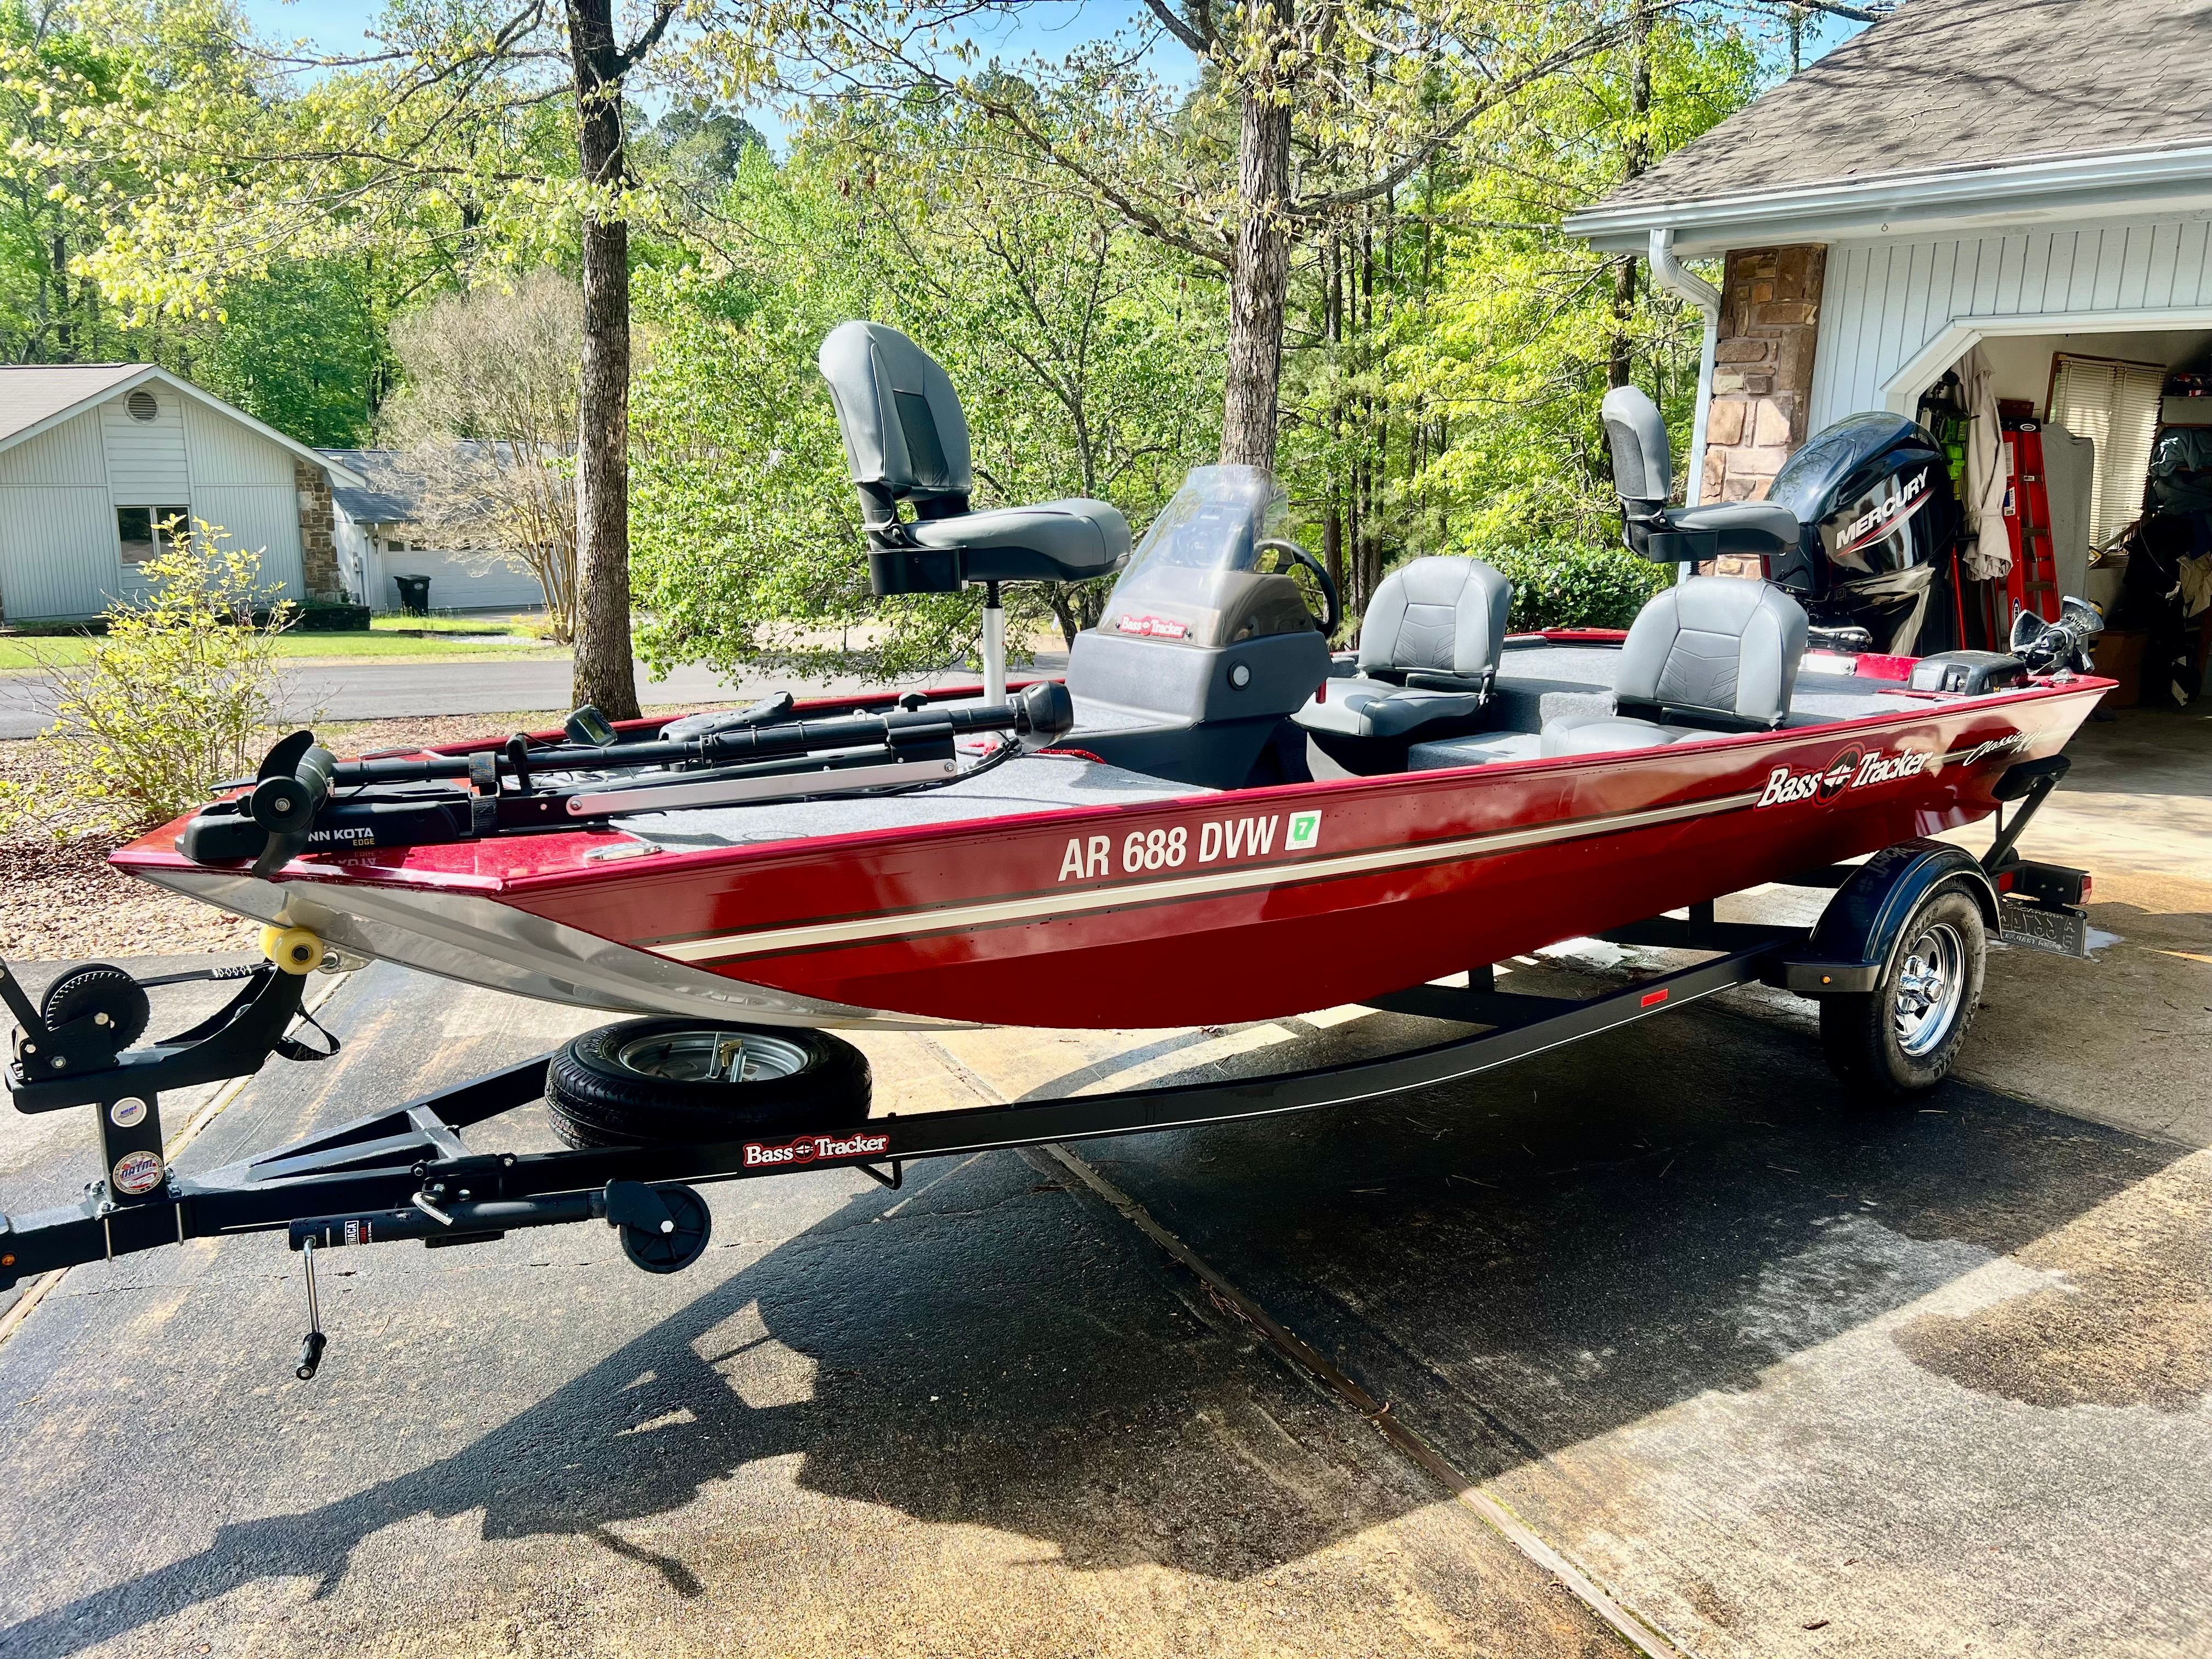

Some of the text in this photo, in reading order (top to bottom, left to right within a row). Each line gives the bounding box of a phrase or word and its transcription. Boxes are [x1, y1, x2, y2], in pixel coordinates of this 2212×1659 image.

[1836, 466, 1928, 549] MERCURY
[1122, 616, 1184, 635] Bass Tracker
[1963, 731, 2026, 766] Classic
[1757, 747, 1933, 807] Bass Tracker
[308, 827, 374, 842] NN KOTA
[1298, 821, 1308, 835] 7
[1058, 815, 1279, 881] AR 688 DVW
[746, 1136, 886, 1164] Bass Tracker
